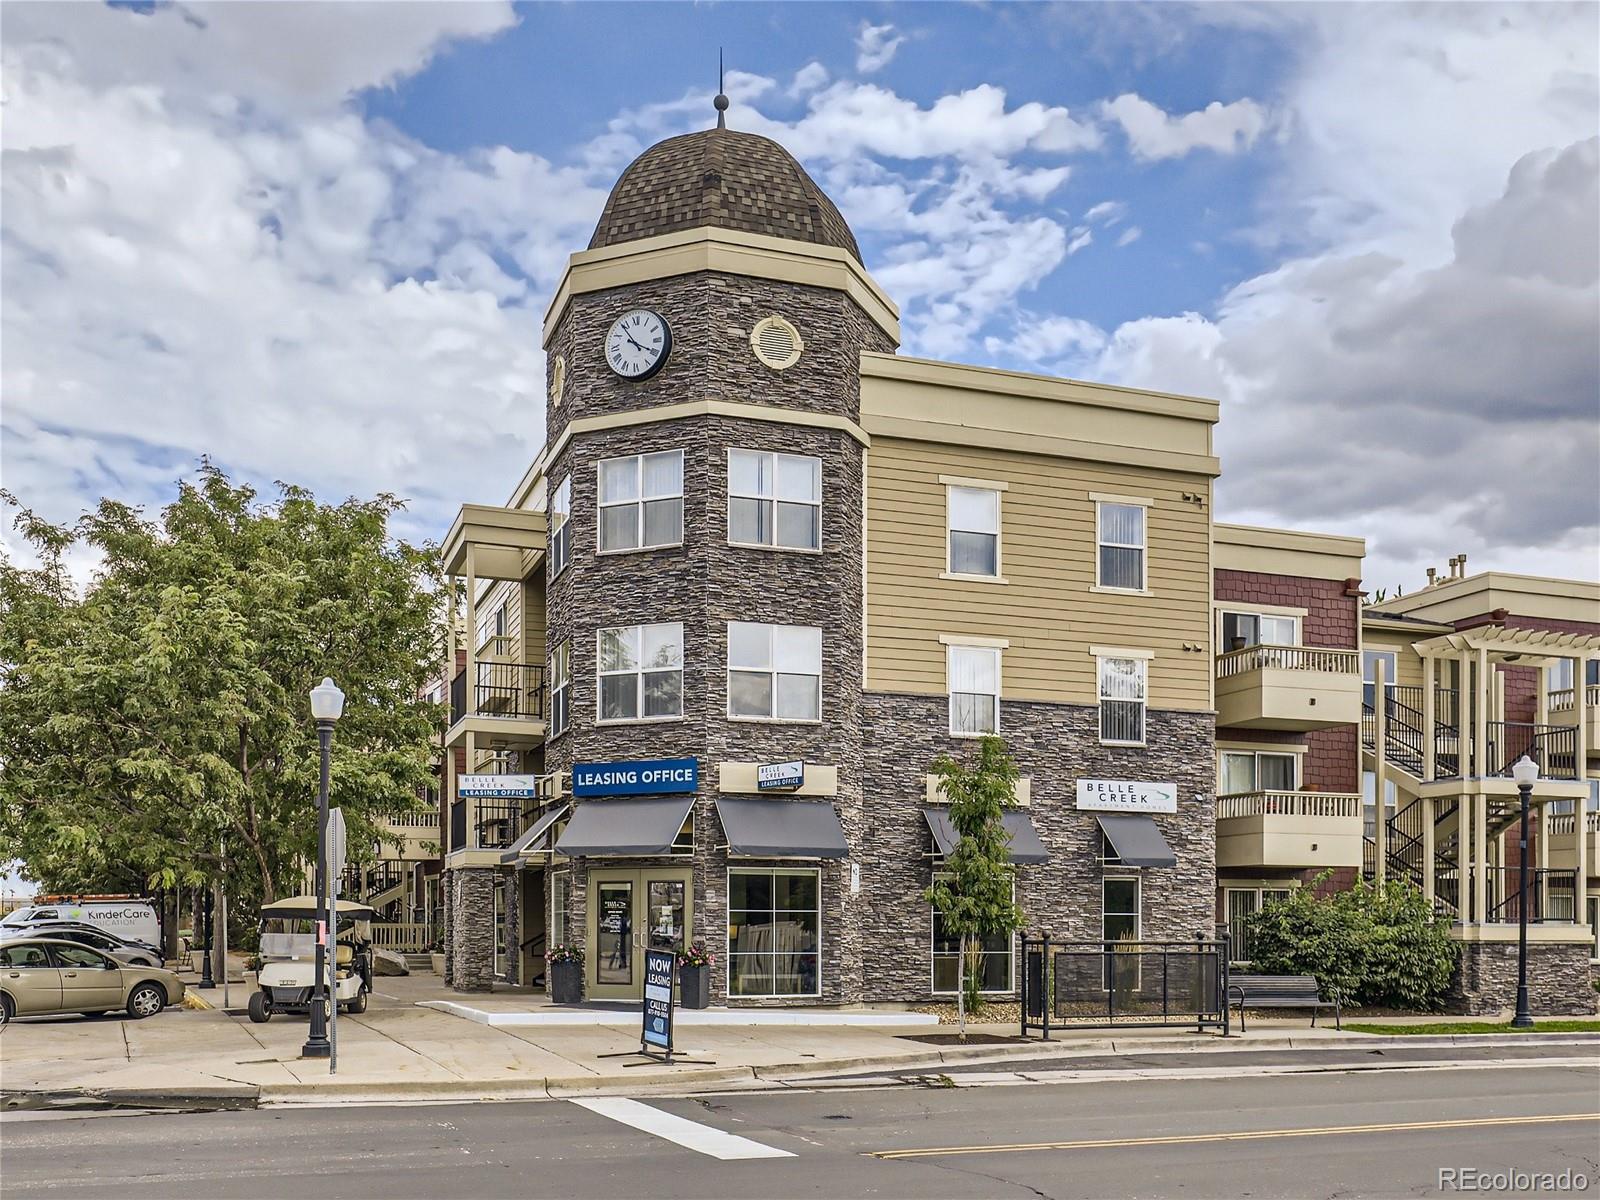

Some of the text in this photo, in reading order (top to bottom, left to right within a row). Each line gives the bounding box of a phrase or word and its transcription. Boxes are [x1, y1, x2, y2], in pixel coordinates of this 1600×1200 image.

[578, 769, 692, 786] LEASING OFFICE
[1087, 783, 1134, 793] BELLE
[1099, 793, 1148, 804] CREEK
[88, 908, 150, 920] KinderCare
[649, 958, 671, 973] NOW
[648, 973, 671, 987] LEASING
[650, 1000, 668, 1012] CALL US
